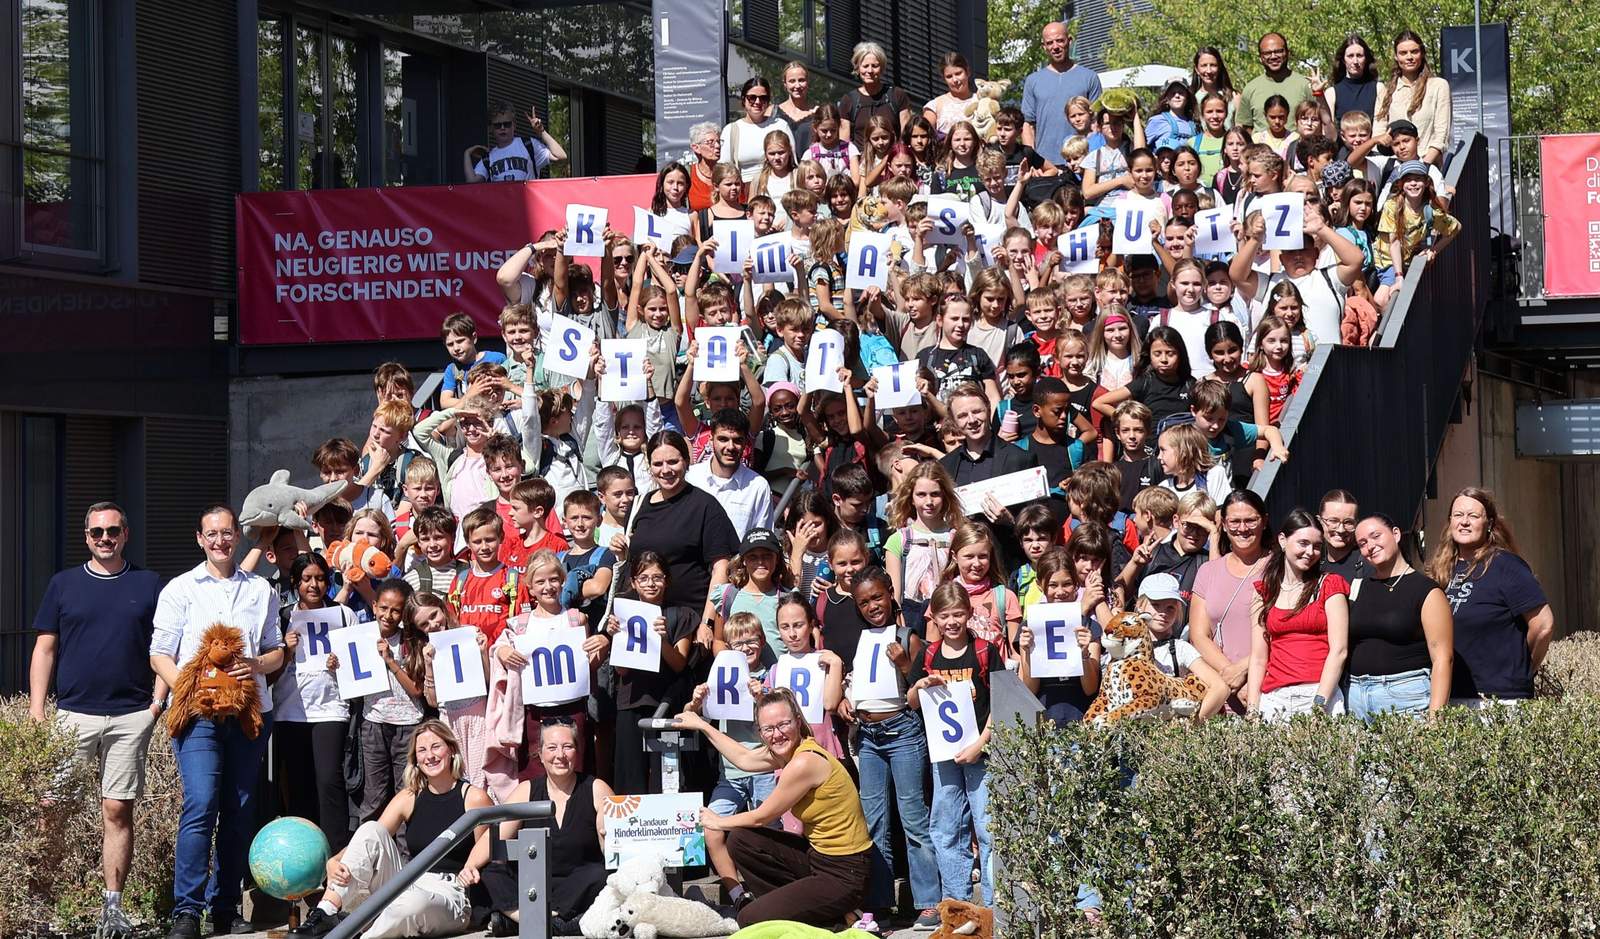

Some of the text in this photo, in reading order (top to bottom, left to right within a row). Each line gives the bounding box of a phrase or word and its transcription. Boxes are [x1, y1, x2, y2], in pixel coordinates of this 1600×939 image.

[1451, 47, 1474, 74] K
[1586, 157, 1600, 171] D
[576, 213, 595, 244] K
[647, 215, 662, 238] L
[939, 208, 957, 236] S
[1125, 210, 1143, 241] U
[1205, 213, 1221, 241] T
[1275, 205, 1289, 237] Z
[274, 227, 433, 254] NA, GENAUSO
[730, 231, 737, 266] I
[1069, 231, 1089, 262] H
[276, 254, 403, 277] NEUGIERIG
[407, 252, 450, 272] WIE
[858, 245, 878, 278] A
[276, 278, 463, 304] FORSCHENDEN?
[560, 328, 581, 361] S
[707, 336, 727, 368] A
[614, 351, 632, 386] T
[461, 604, 502, 613] AUTRE
[308, 623, 331, 656] K
[627, 615, 648, 653] A
[1045, 620, 1067, 660] E
[348, 642, 372, 680] L
[452, 644, 463, 683] I
[870, 643, 880, 683] I
[717, 666, 740, 704] K
[790, 668, 811, 706] R
[939, 700, 963, 743] S
[614, 825, 694, 838] Kinderklimakonferenz
[639, 818, 669, 827] Landauer
